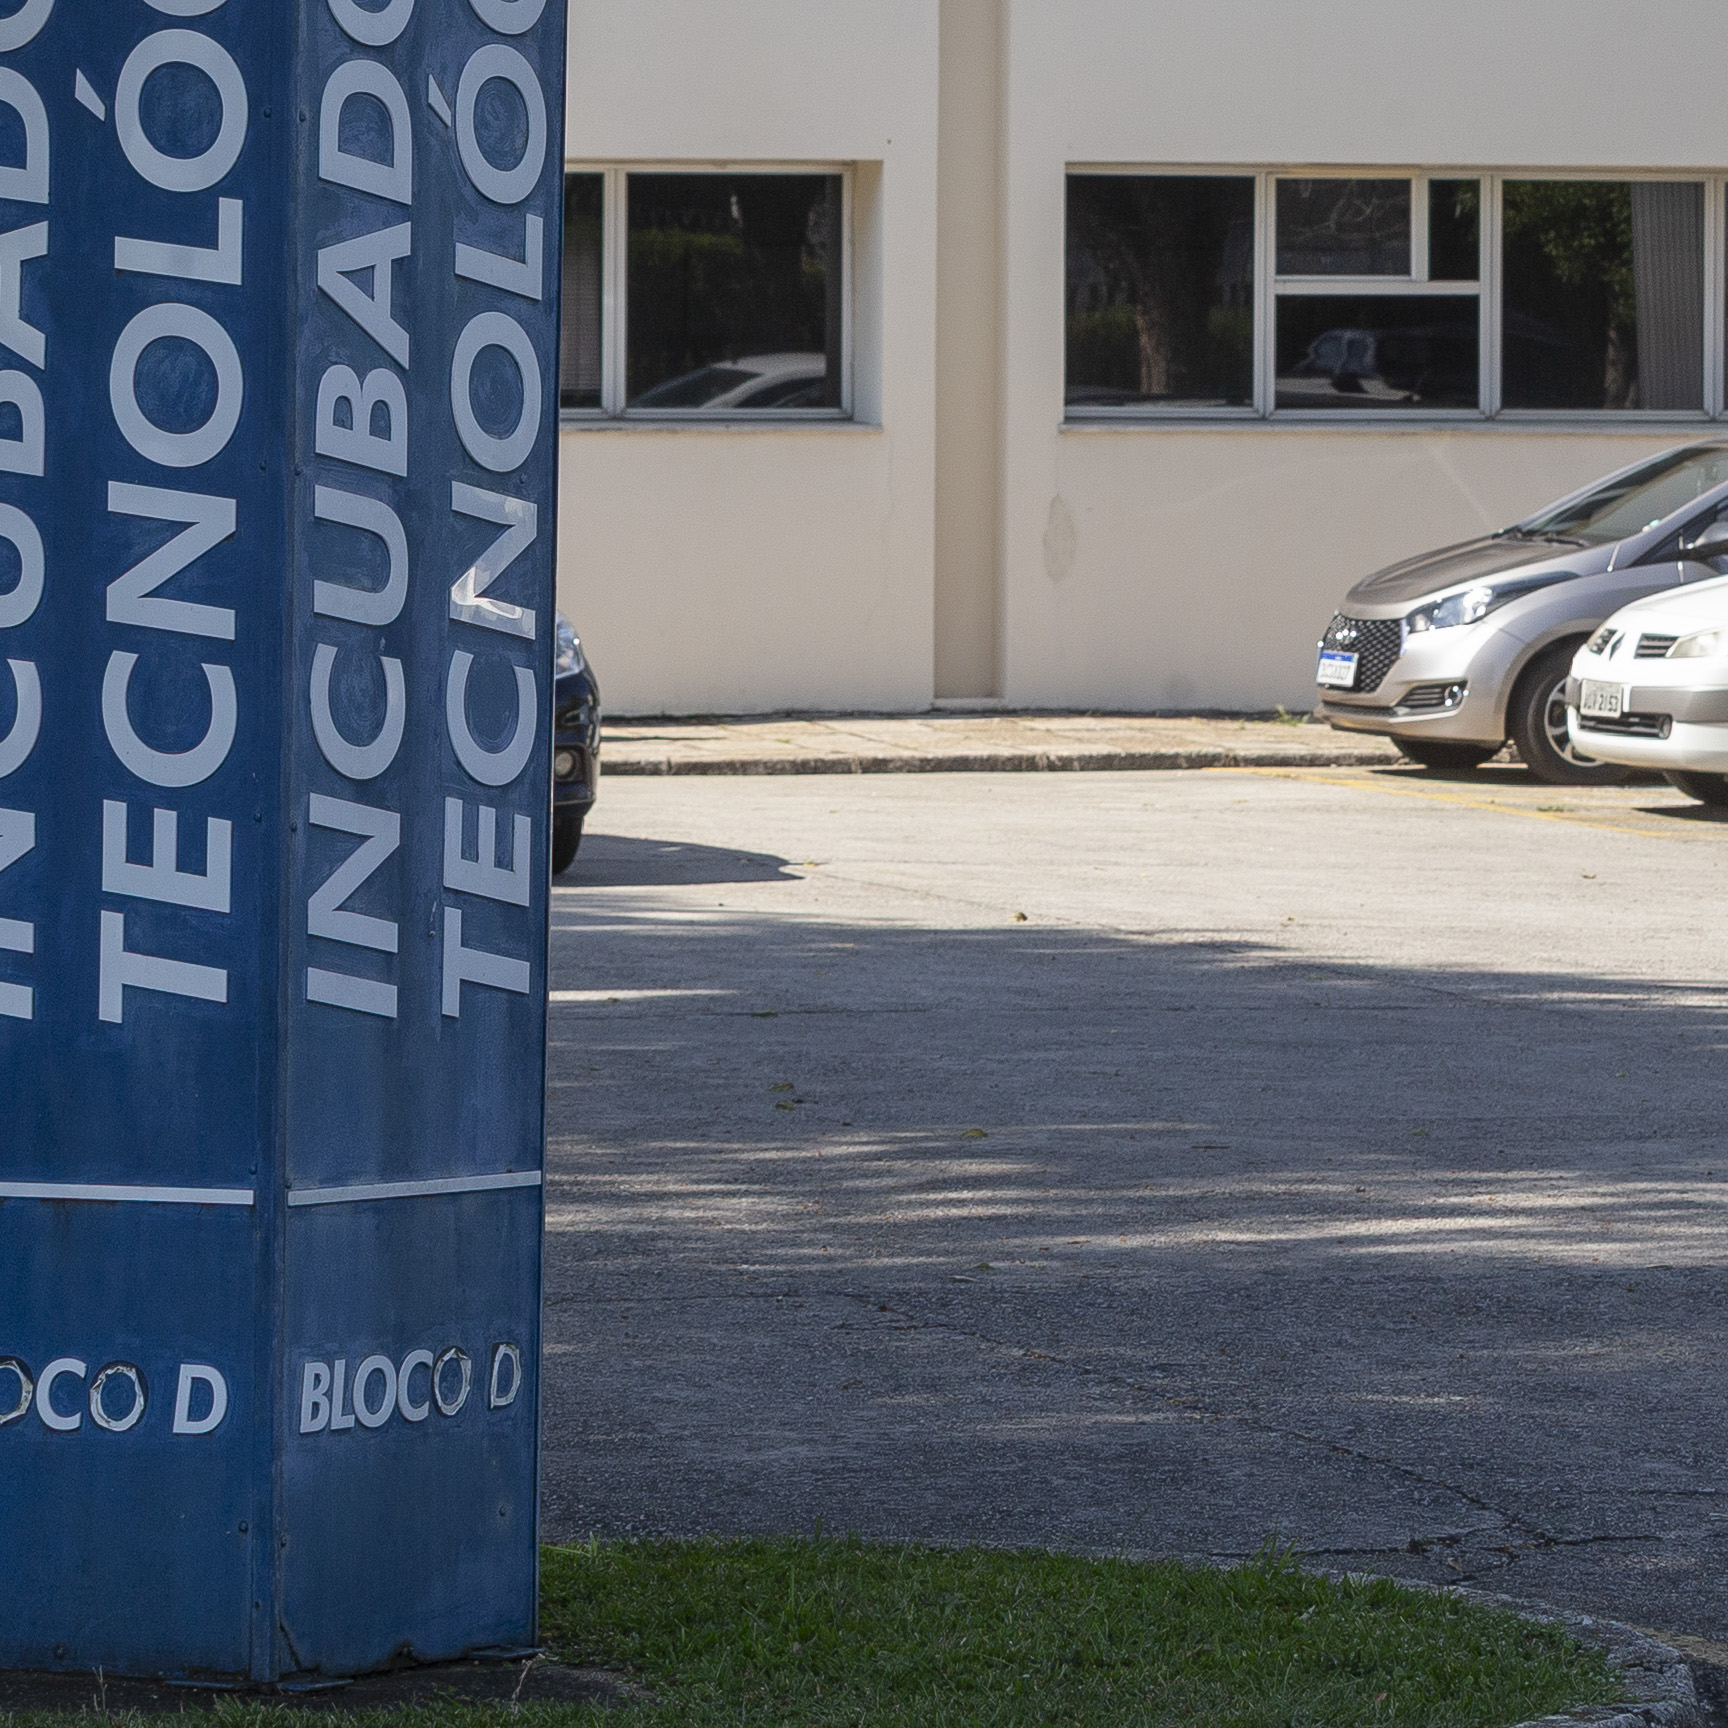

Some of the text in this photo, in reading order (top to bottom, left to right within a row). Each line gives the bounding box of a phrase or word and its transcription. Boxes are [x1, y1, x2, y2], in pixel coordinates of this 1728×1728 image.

[172, 1363, 228, 1434] D
[299, 1341, 522, 1434] BLOCO D
